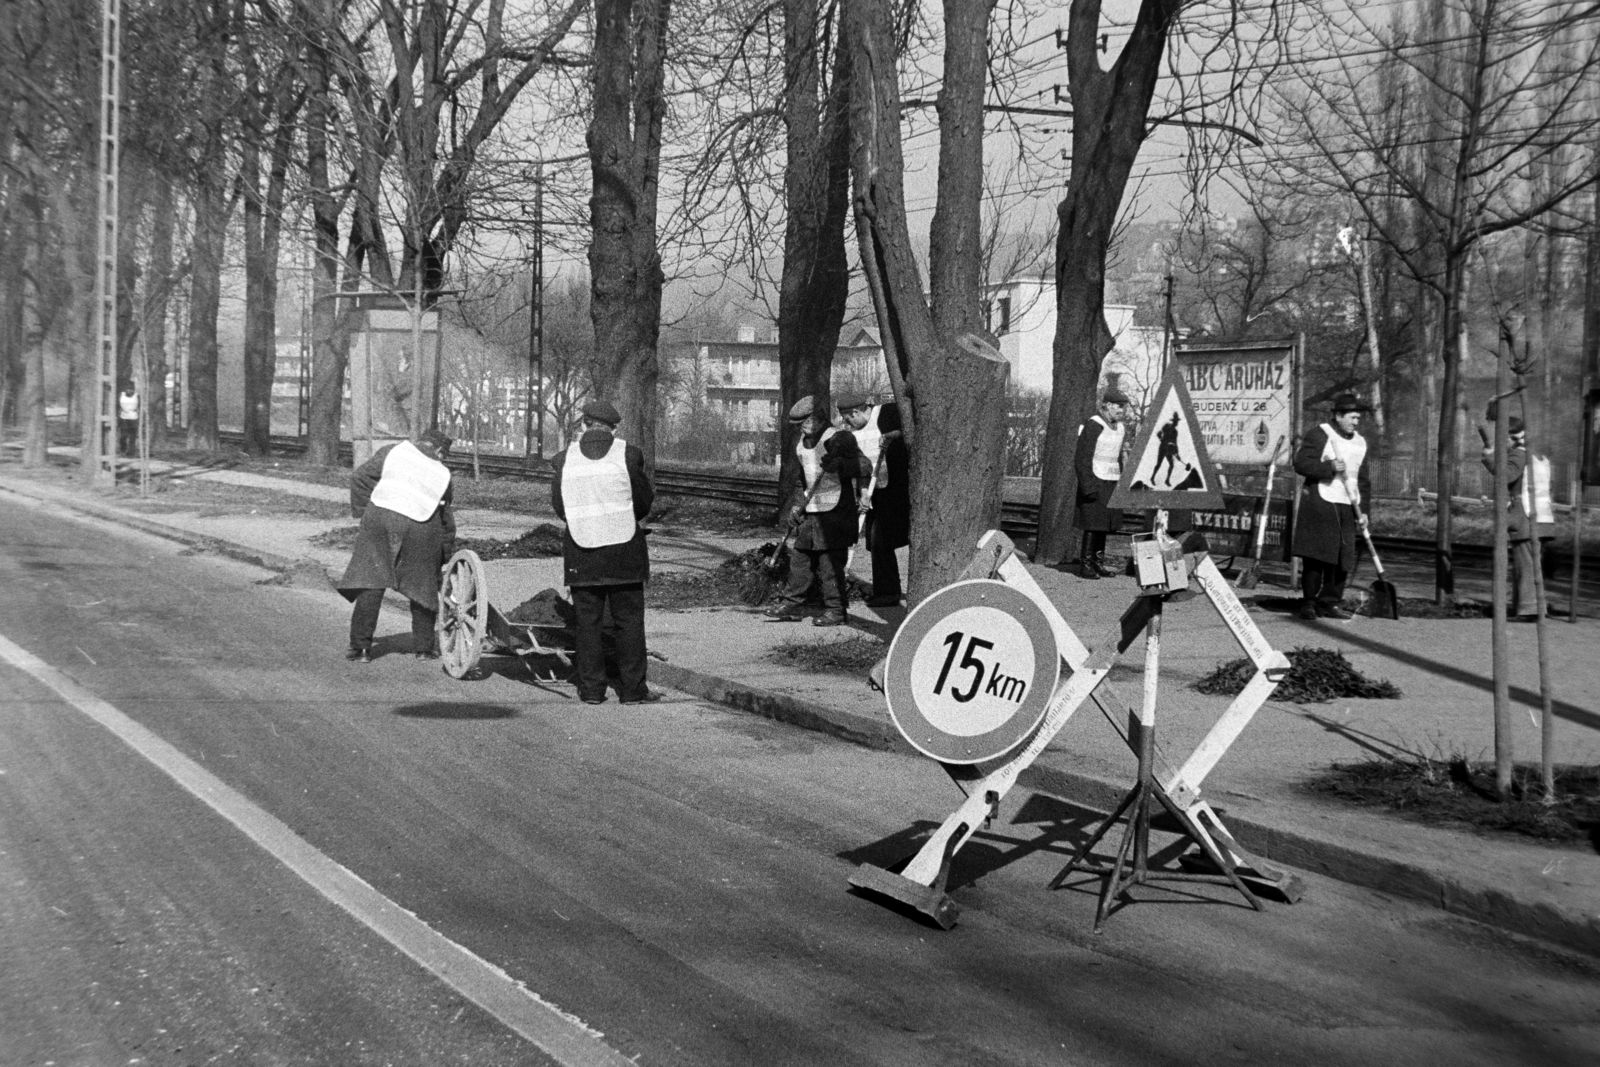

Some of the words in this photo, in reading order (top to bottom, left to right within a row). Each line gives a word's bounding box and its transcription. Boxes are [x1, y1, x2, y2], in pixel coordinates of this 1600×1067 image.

[1186, 364, 1221, 391] ABC
[1193, 402, 1237, 411] BUDENZ
[933, 631, 994, 703] 15
[985, 662, 1026, 703] km
